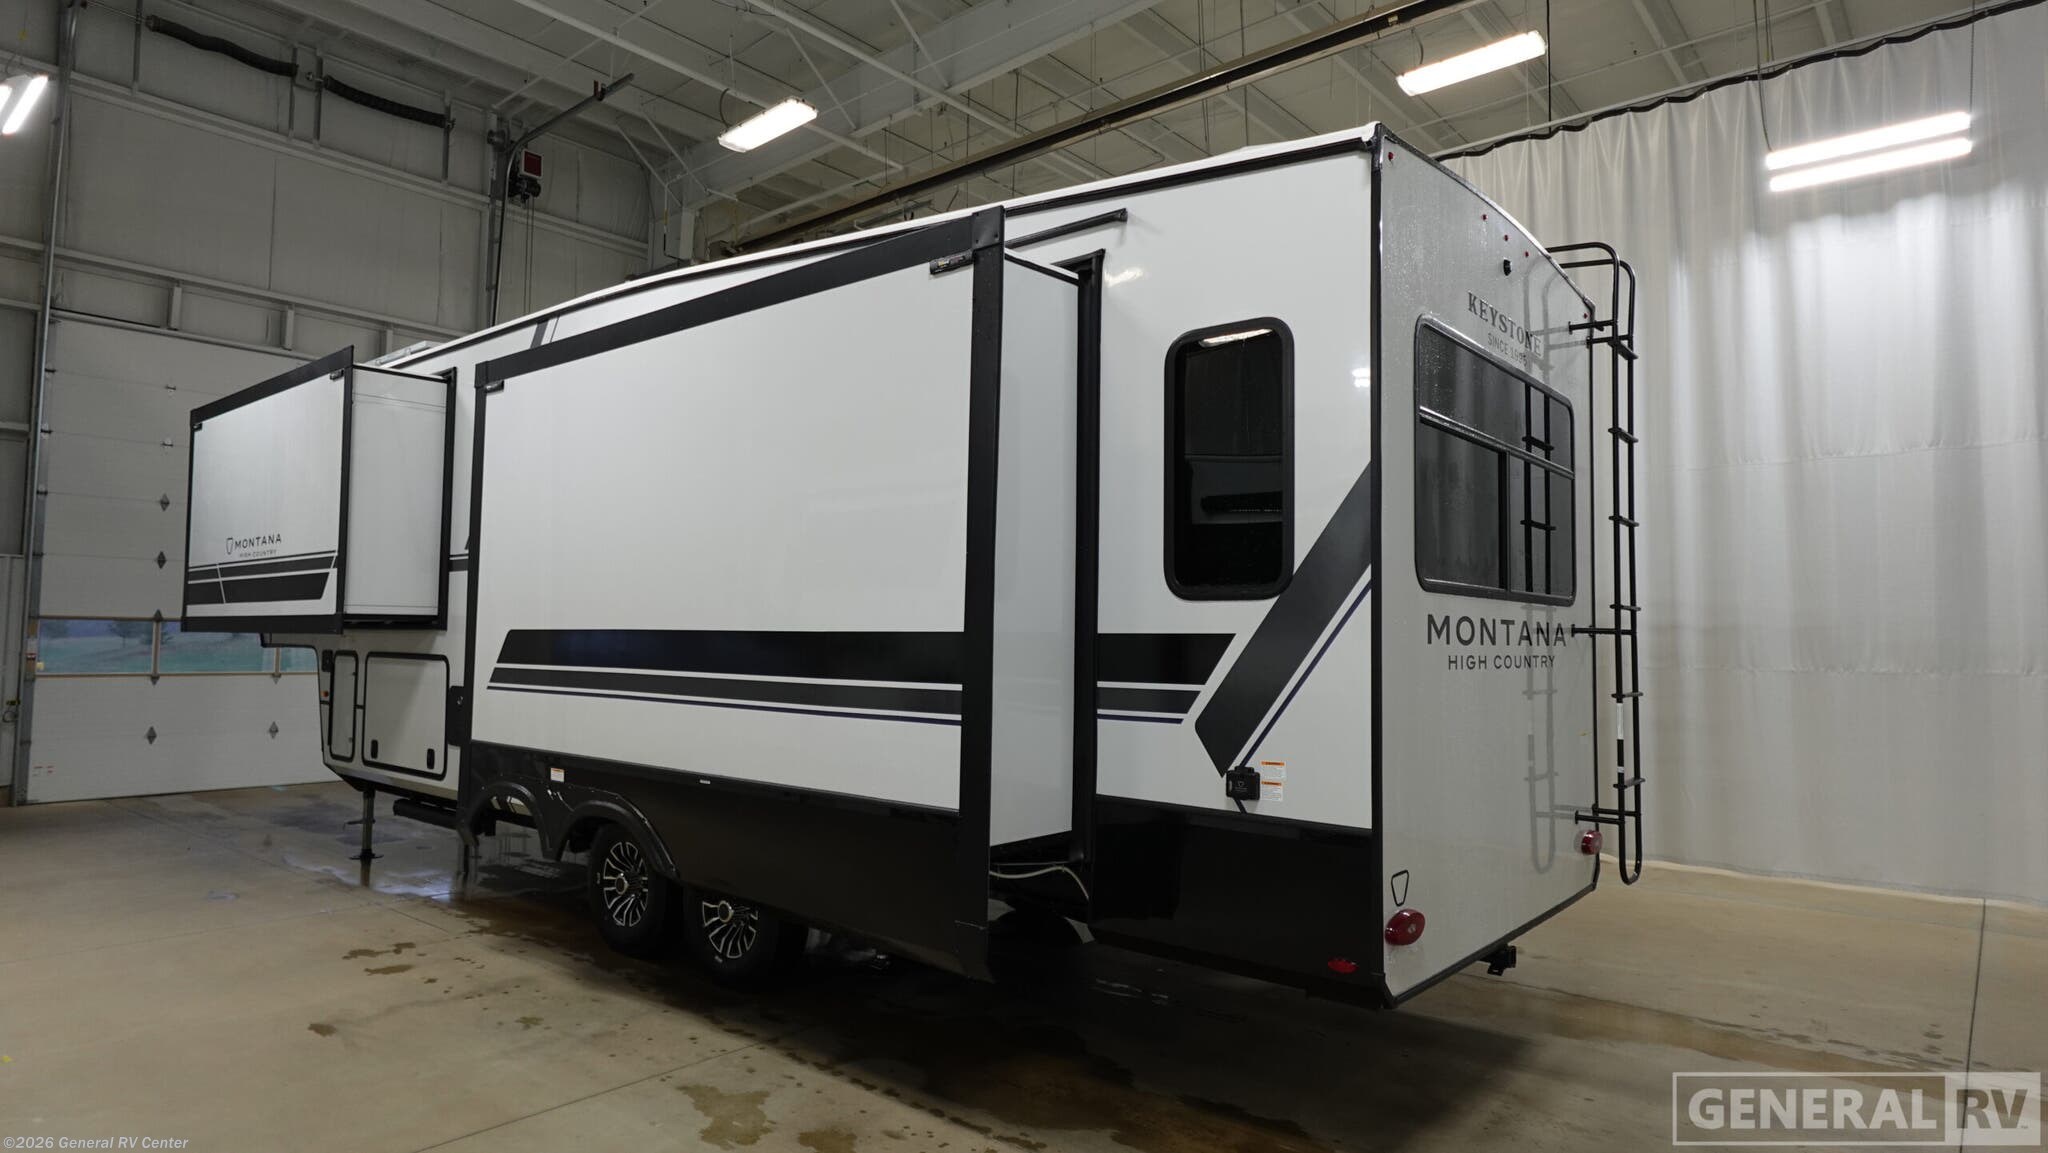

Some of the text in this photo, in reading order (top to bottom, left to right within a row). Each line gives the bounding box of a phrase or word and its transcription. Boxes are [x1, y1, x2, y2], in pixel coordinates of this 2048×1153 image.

[1468, 292, 1542, 357] KEYSTONE
[235, 533, 282, 549] MONTANA
[1427, 614, 1566, 646] MONTANA
[1448, 655, 1555, 670] HIGH COUNTRY
